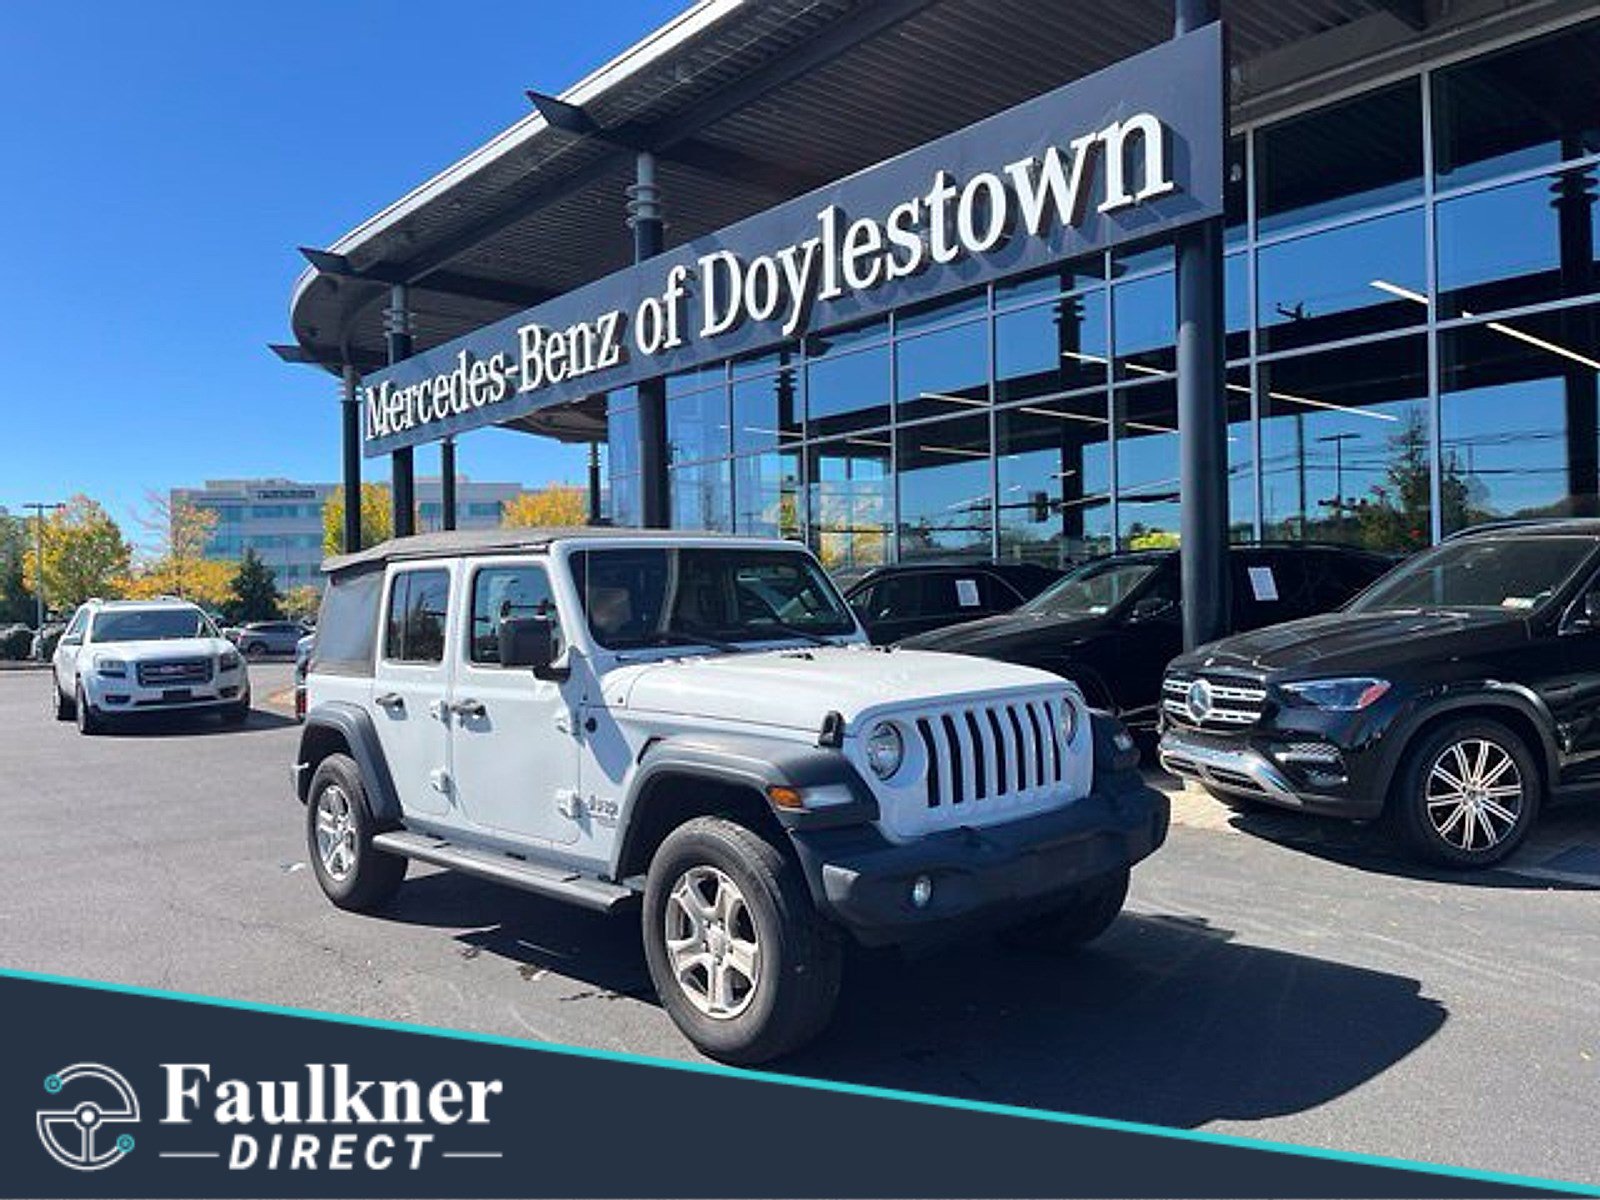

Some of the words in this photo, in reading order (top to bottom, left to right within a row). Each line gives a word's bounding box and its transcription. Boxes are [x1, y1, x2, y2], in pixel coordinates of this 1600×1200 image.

[364, 309, 619, 440] Mercedes-Benz
[635, 264, 686, 354] of
[699, 112, 1174, 336] Doylestown
